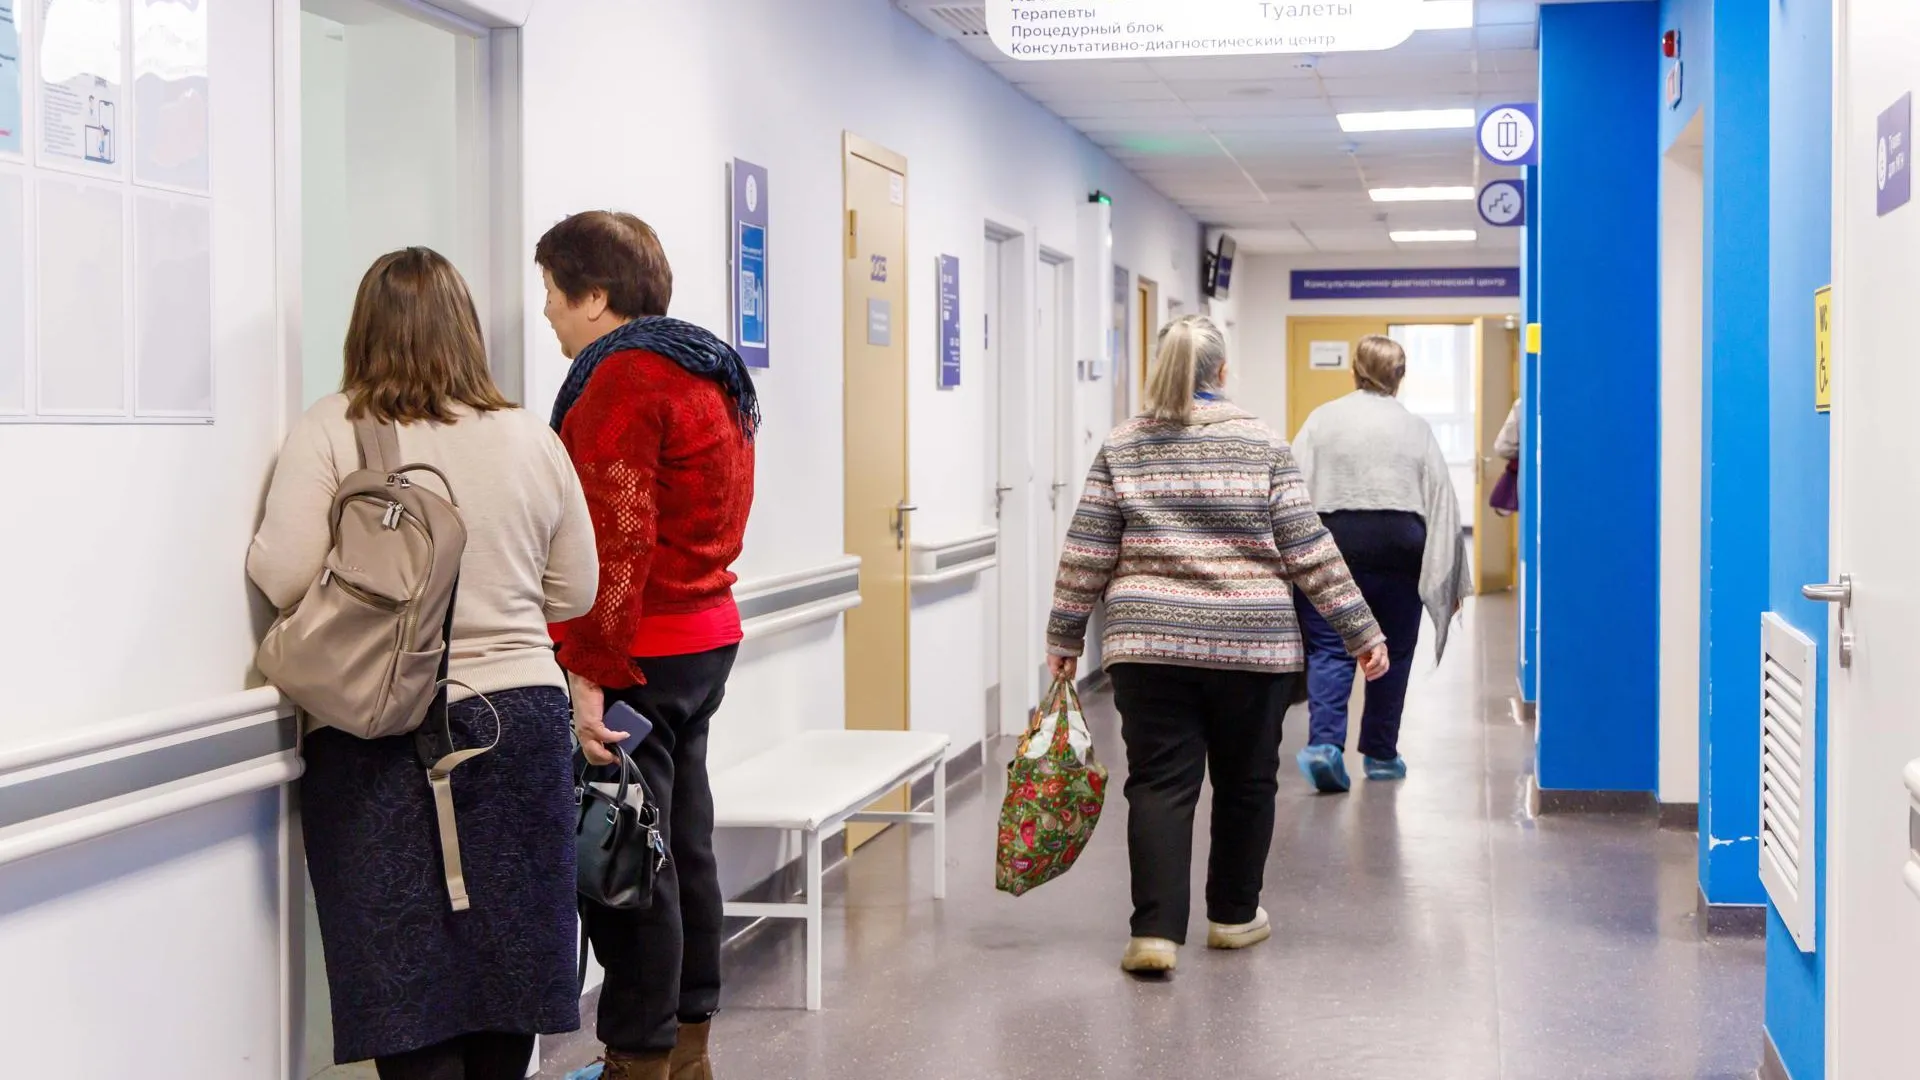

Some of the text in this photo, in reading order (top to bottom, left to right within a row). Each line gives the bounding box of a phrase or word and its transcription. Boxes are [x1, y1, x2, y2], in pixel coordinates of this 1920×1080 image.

[1011, 8, 1096, 22] Терапевты
[1259, 2, 1353, 21] Туалеты
[1011, 22, 1165, 39] Процедурный блок
[1288, 35, 1336, 47] центр
